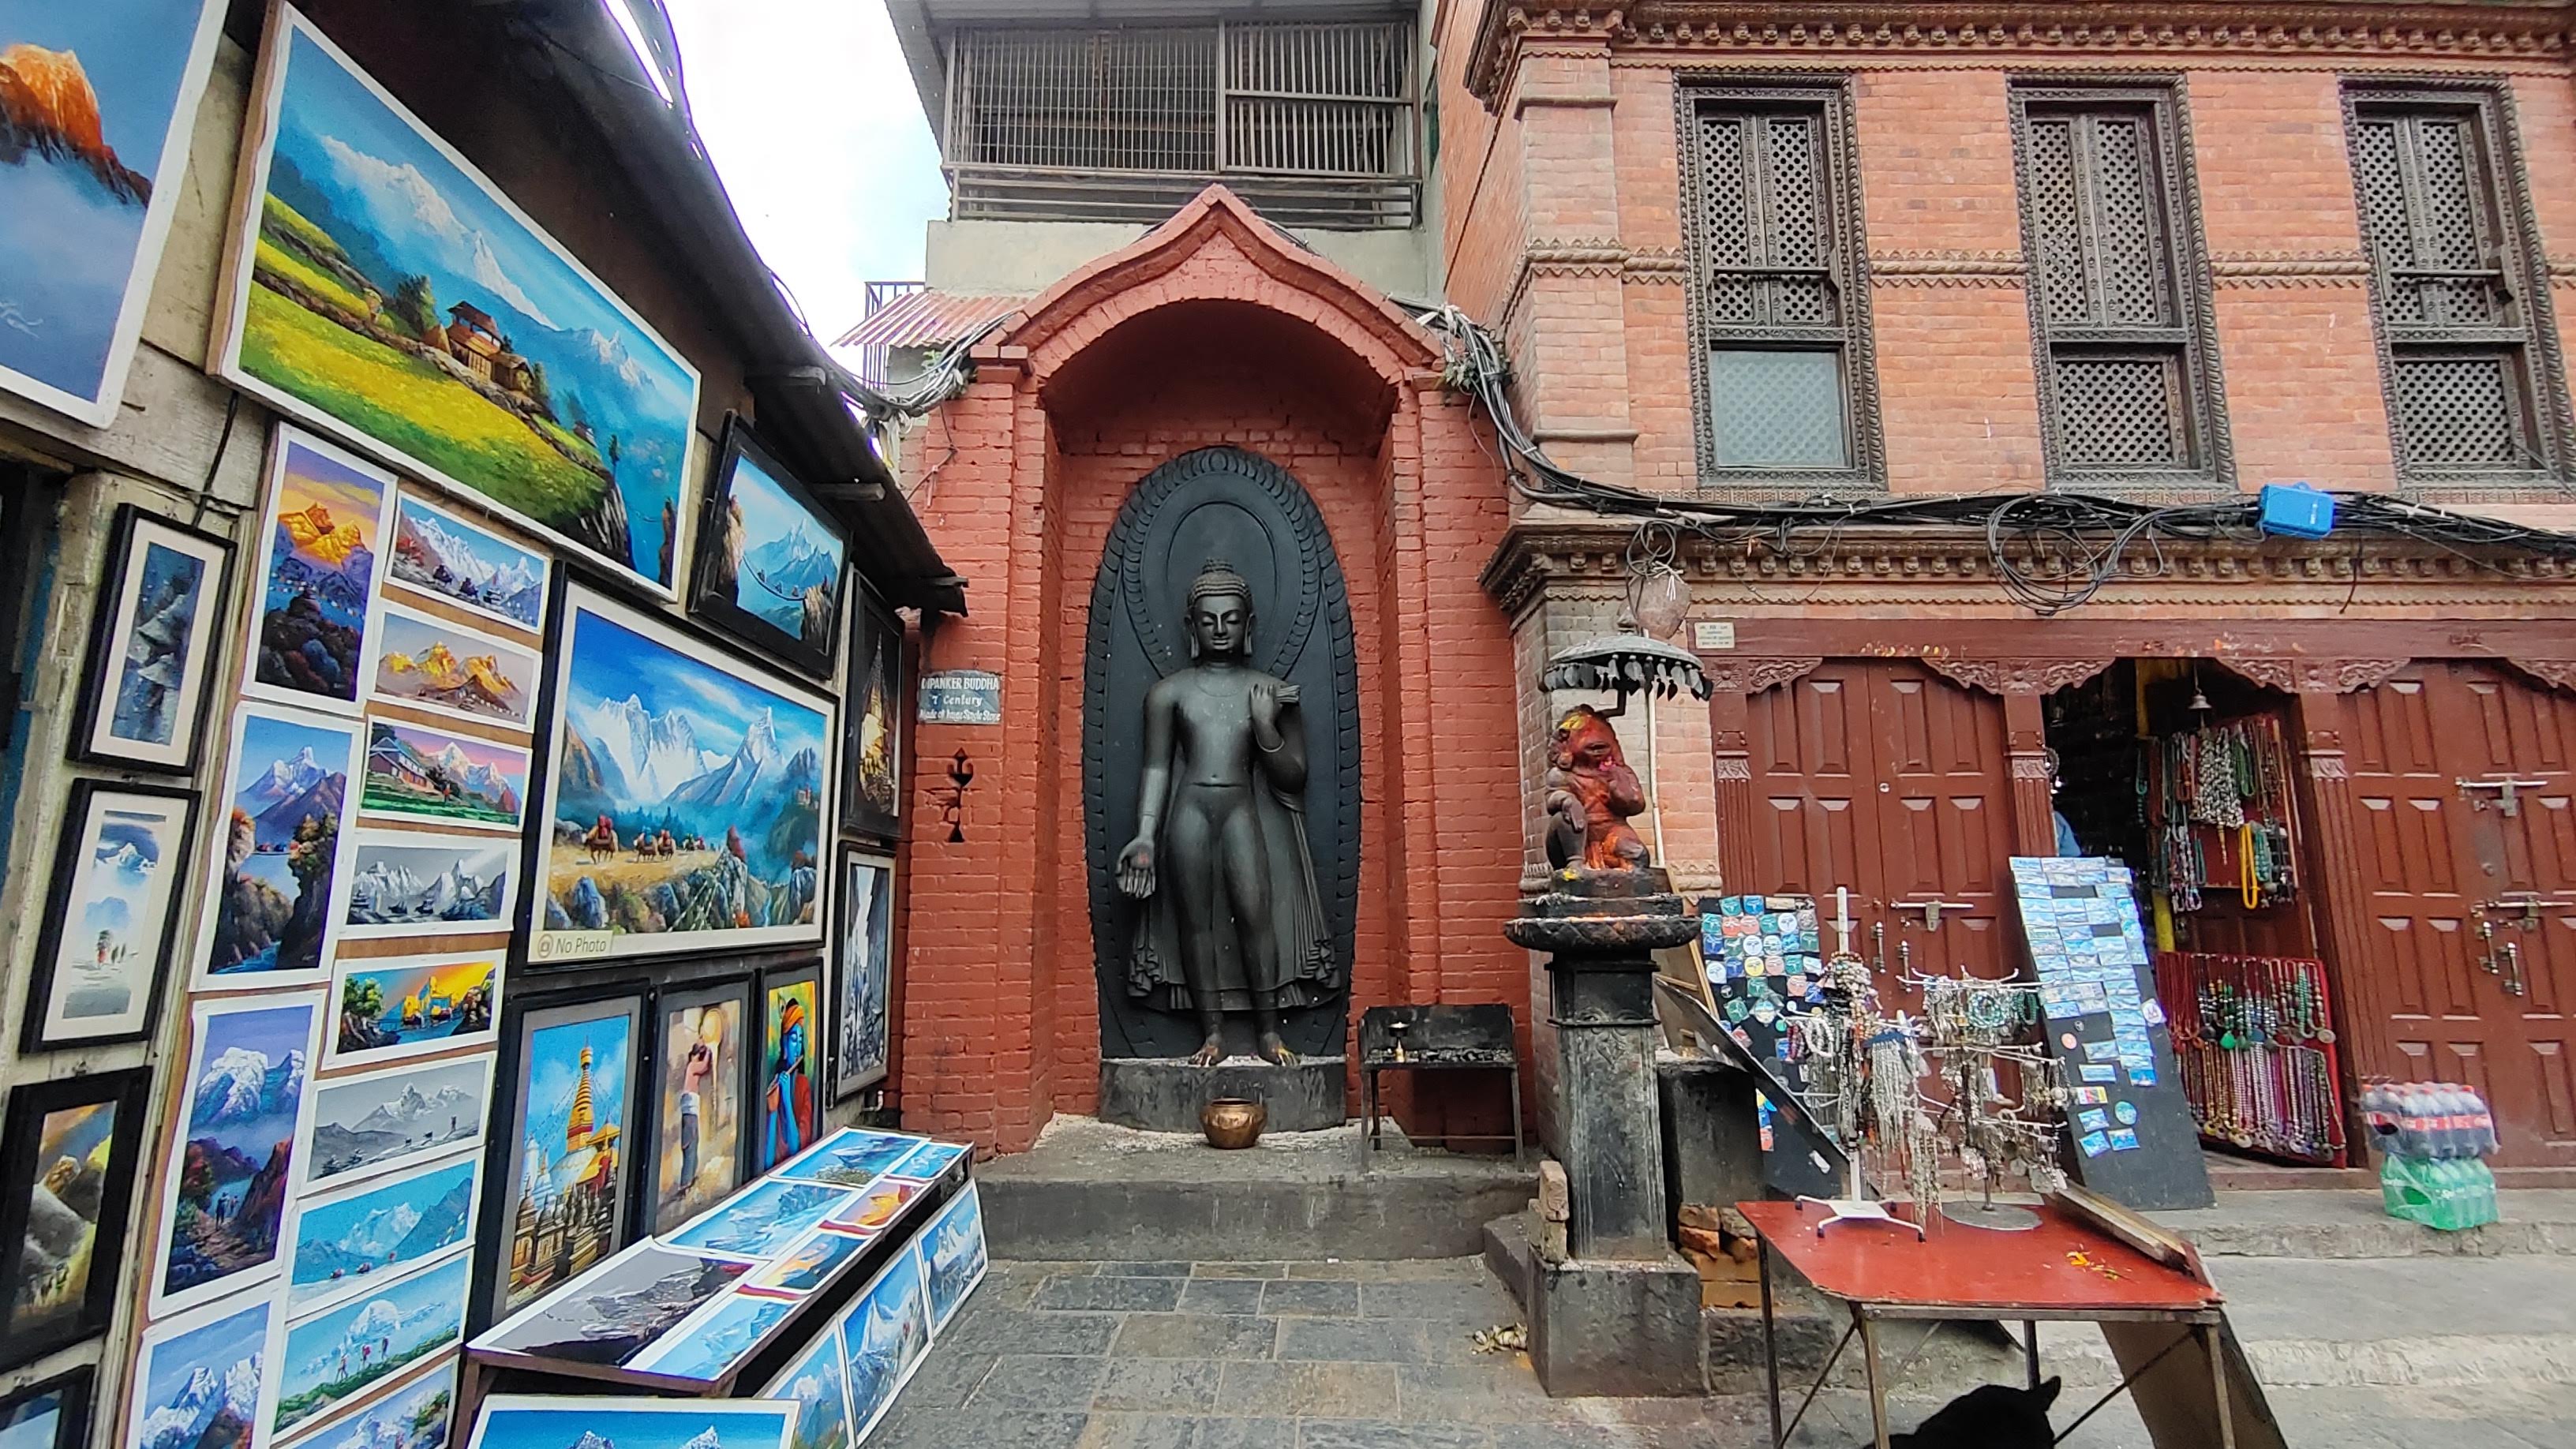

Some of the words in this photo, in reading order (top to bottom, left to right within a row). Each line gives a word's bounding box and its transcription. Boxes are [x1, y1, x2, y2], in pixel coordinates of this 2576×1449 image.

[964, 677, 999, 691] BUDDHA
[932, 695, 939, 705] 7
[943, 694, 983, 707] Century
[556, 938, 572, 954] No
[575, 936, 607, 953] Photo
